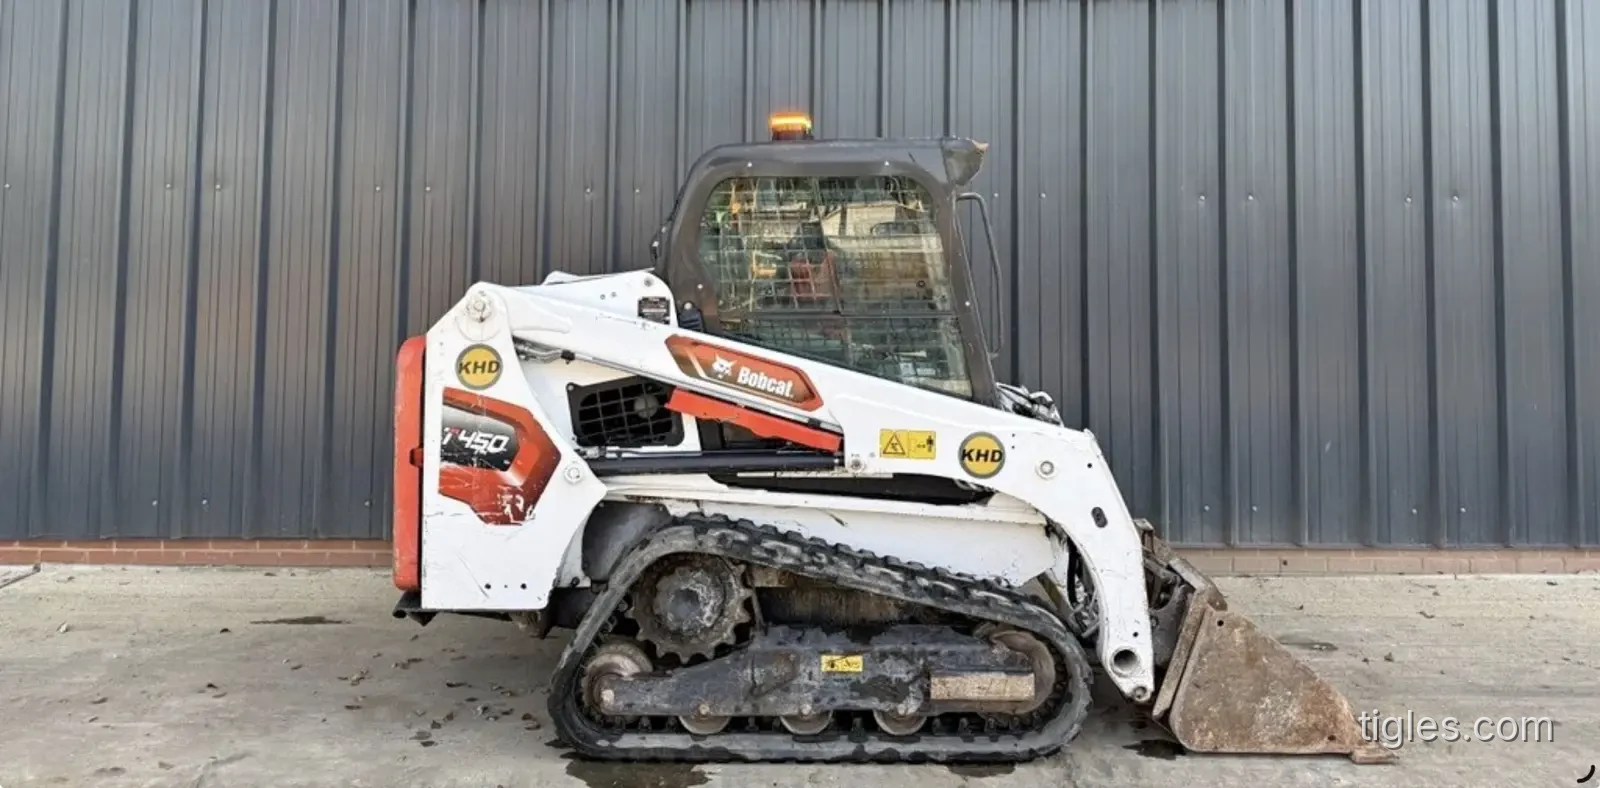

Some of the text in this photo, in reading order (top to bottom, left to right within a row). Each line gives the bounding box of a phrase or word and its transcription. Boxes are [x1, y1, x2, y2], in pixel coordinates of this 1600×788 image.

[458, 359, 501, 375] KHD
[737, 367, 793, 397] Bobcat
[442, 427, 510, 454] T450
[961, 448, 1003, 463] KHD
